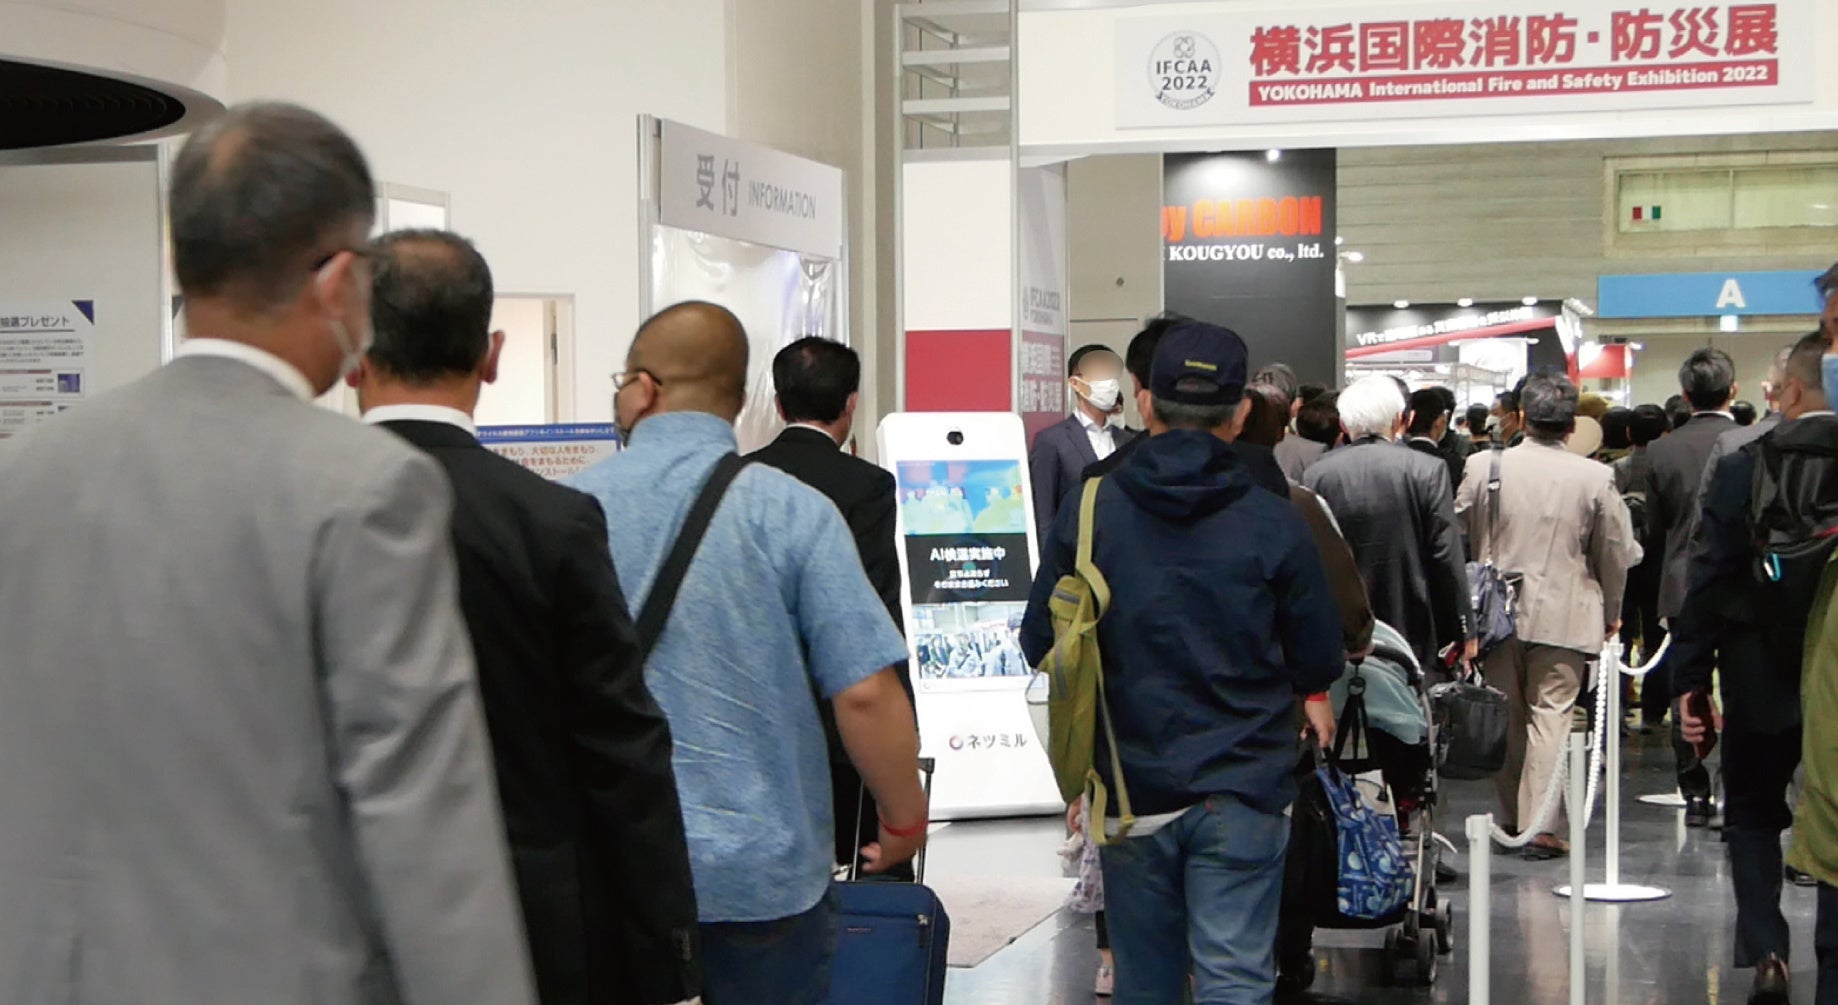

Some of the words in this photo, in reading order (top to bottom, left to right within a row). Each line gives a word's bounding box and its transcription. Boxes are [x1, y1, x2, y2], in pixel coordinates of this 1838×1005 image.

[1249, 4, 1779, 77] 横浜国際消防・防災展
[1156, 59, 1212, 75] IFCAA
[1162, 76, 1207, 91] 2022
[1258, 82, 1363, 101] YOKOHAMA
[1369, 77, 1482, 97] International
[1488, 75, 1522, 92] Fire
[1527, 74, 1558, 90] and
[1563, 72, 1622, 91] Safety
[1628, 68, 1718, 86] Exhibition
[1723, 65, 1768, 82] 2022
[696, 154, 740, 216] 受付
[749, 181, 817, 219] INFORMATION
[1193, 196, 1323, 237] CARBON
[1169, 244, 1264, 261] KOUGYOU
[1267, 247, 1294, 262] co.,
[1298, 243, 1324, 258] ltd.
[1716, 279, 1746, 308] A
[930, 546, 1006, 562] AI検温実施中
[968, 734, 1027, 749] ネツミル
